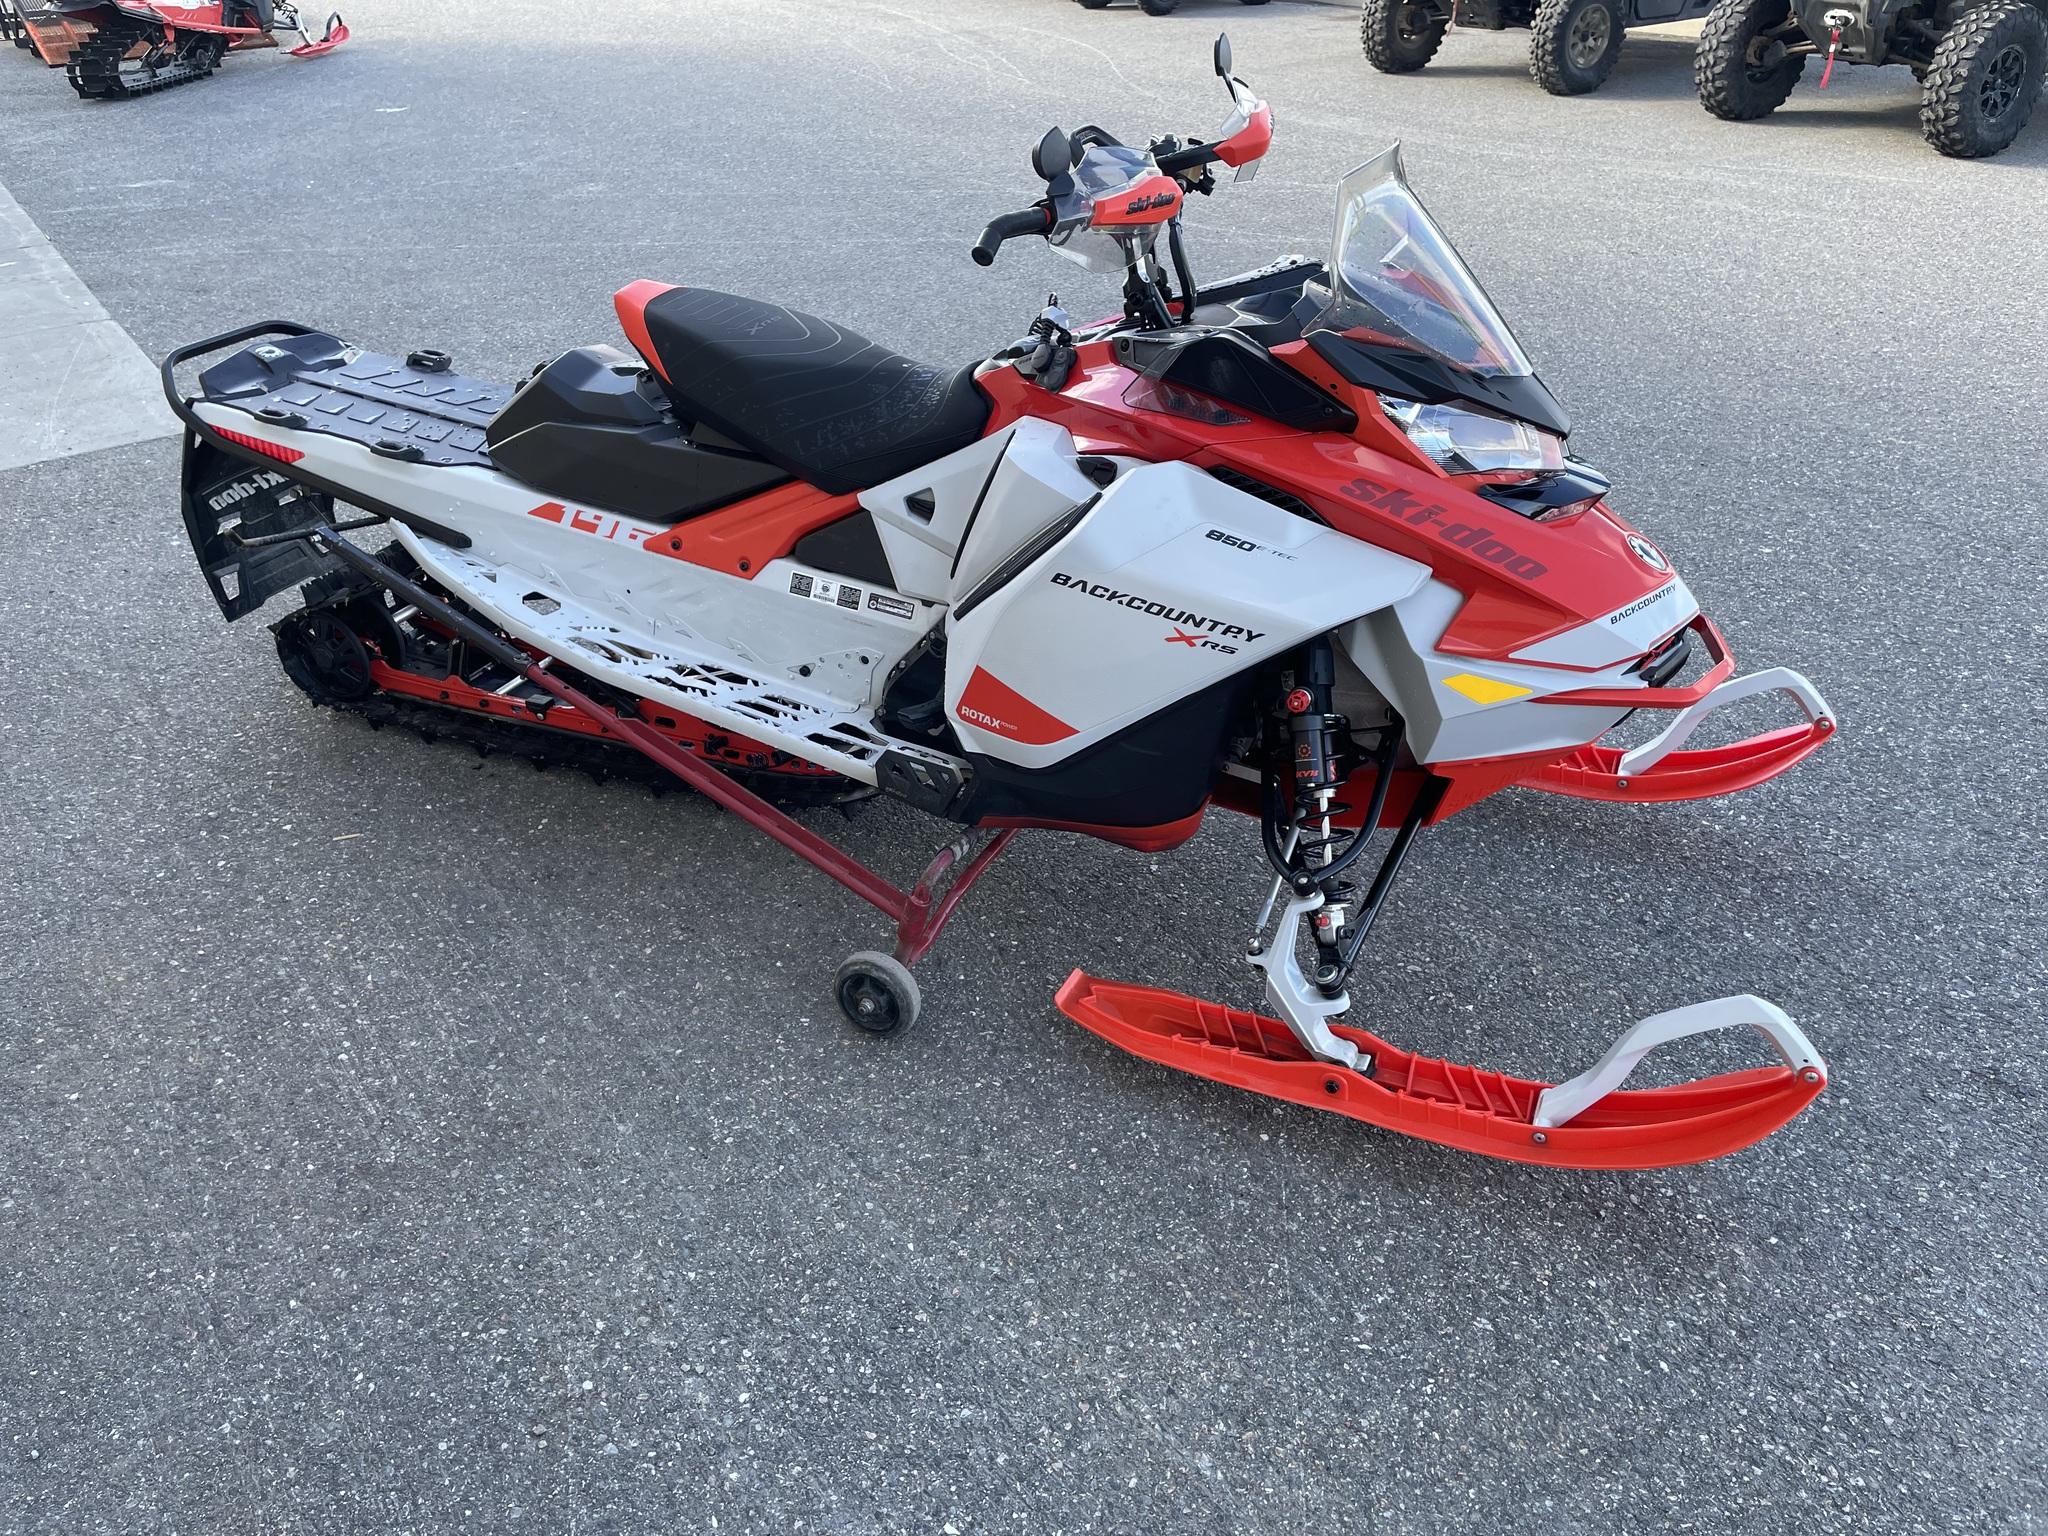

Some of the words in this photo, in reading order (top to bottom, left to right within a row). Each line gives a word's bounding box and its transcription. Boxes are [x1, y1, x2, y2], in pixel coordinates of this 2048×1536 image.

[1125, 192, 1176, 215] ski-doo
[1205, 529, 1257, 552] 850
[1256, 545, 1299, 562] E-TEC
[1340, 478, 1549, 580] ski-doo
[1050, 572, 1266, 642] BACKCOUNTRY
[1610, 583, 1677, 625] BACKCOUNTRY
[961, 705, 1001, 729] ROTAX
